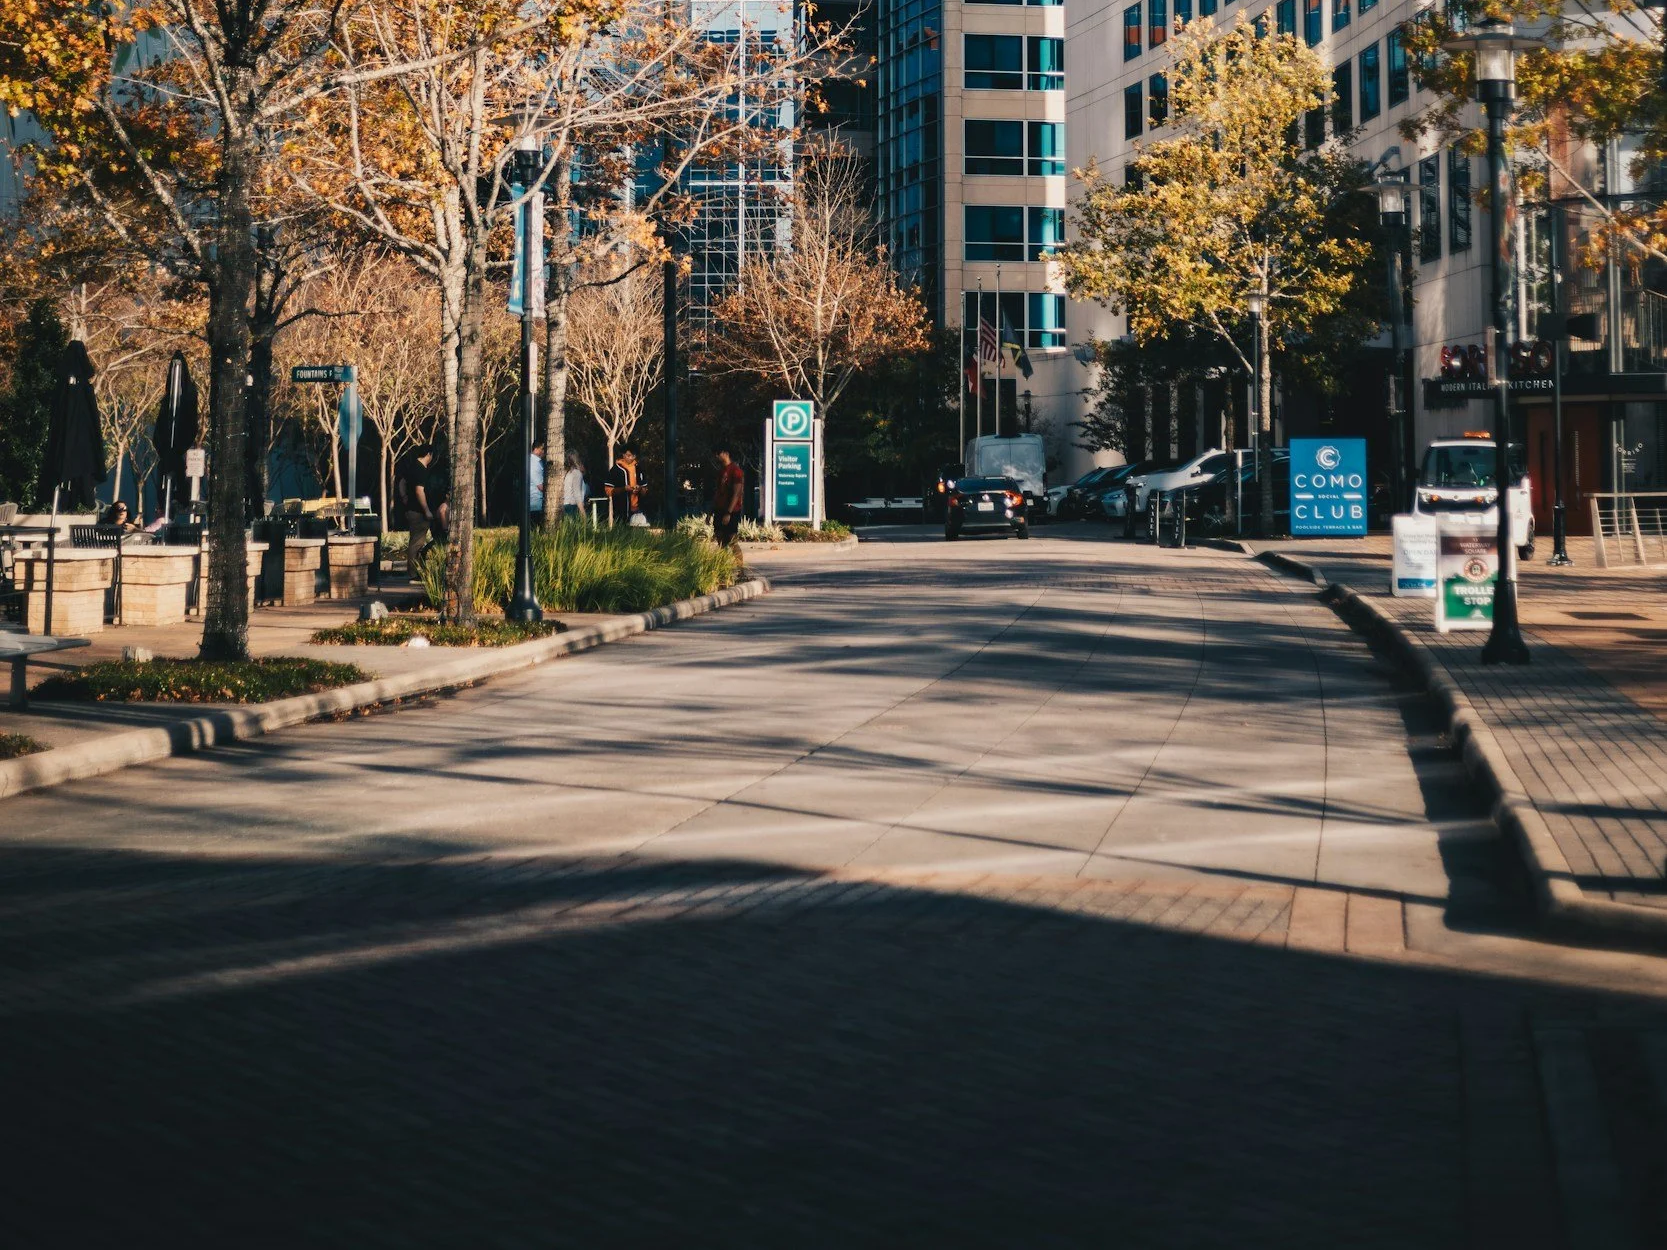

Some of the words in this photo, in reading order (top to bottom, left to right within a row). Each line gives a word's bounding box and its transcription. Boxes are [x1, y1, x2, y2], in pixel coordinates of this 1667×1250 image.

[296, 370, 327, 379] FOUNTAINS
[1440, 383, 1466, 392] MODERN
[1508, 380, 1555, 390] KITCHEN
[786, 413, 800, 429] P
[1295, 474, 1363, 488] COMO
[1295, 505, 1363, 519] CLUB
[1454, 586, 1495, 595] TROLLE
[1464, 596, 1491, 606] STOP
